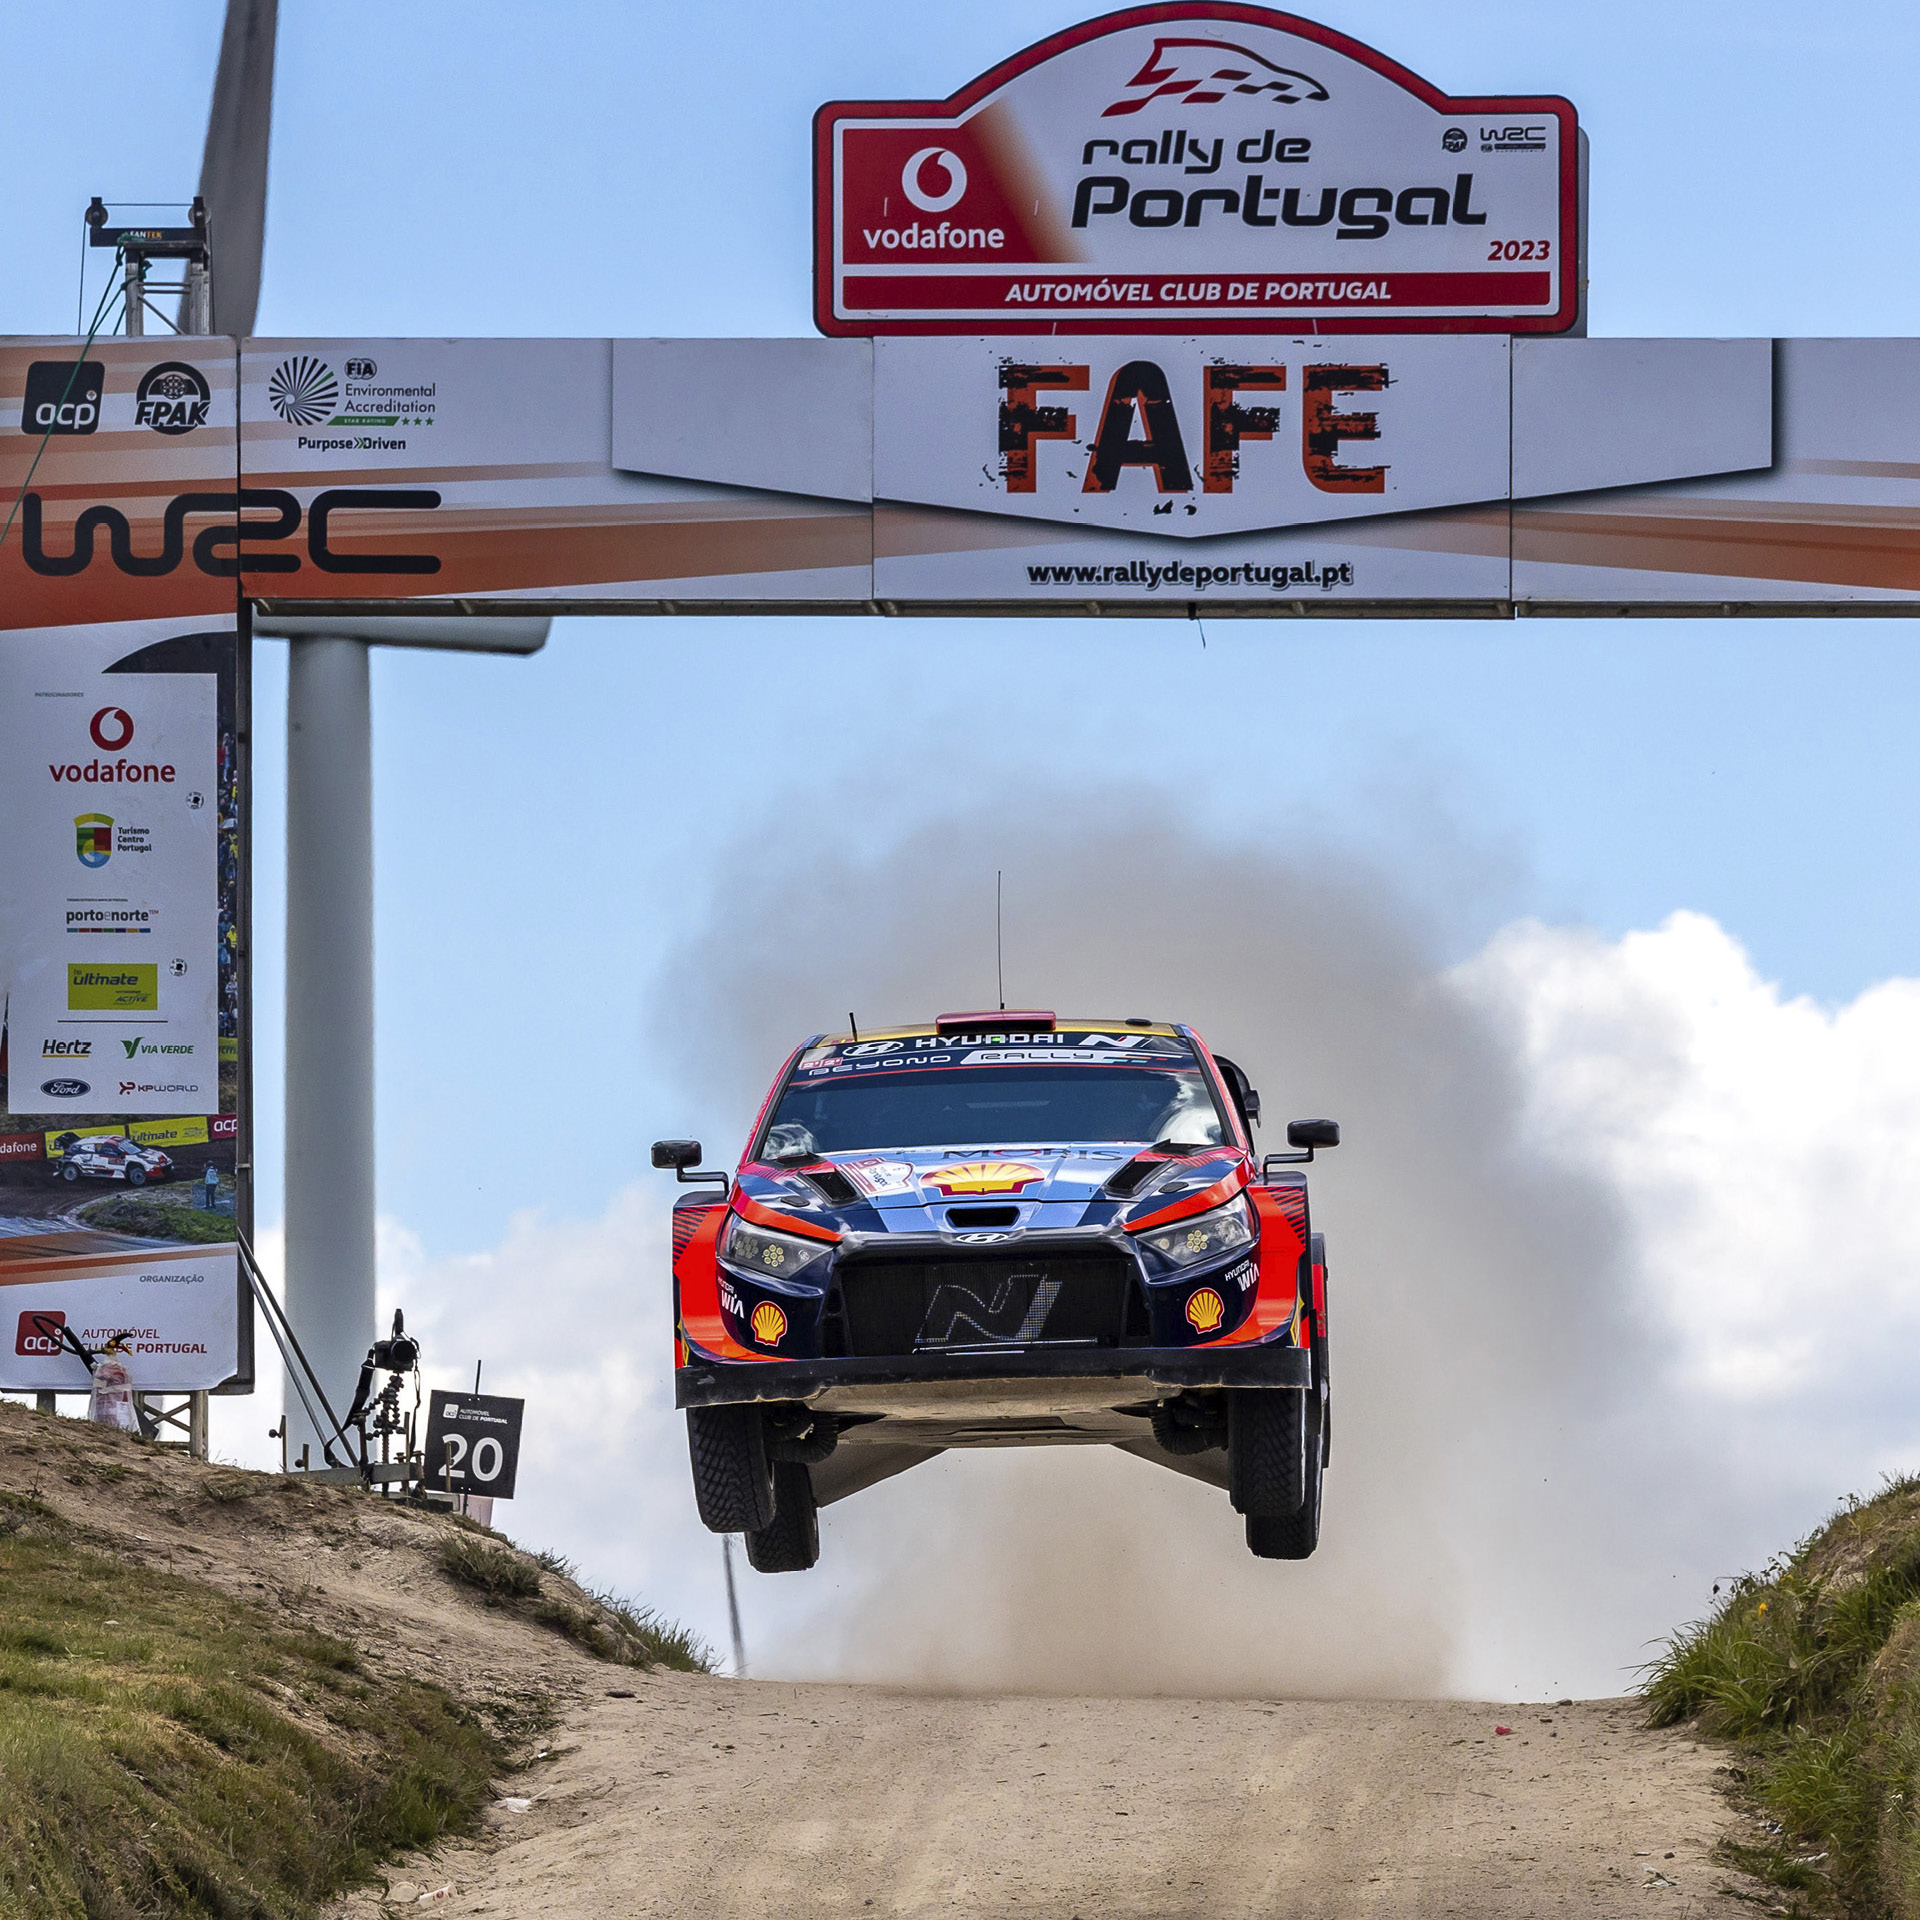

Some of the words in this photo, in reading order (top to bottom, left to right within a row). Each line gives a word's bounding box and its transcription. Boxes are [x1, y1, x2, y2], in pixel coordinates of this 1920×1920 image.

[1480, 126, 1546, 141] WRC
[1082, 130, 1224, 174] rally
[1236, 129, 1311, 164] de
[1071, 173, 1487, 240] Portugal
[863, 222, 1005, 249] vodafone
[1488, 240, 1550, 261] 2023
[1005, 278, 1154, 302] AUTOMÓVEL
[1159, 283, 1223, 301] CLUB
[1227, 283, 1261, 301] DE
[1265, 282, 1391, 301] PORTUGAL
[347, 362, 374, 376] FIA
[346, 382, 436, 397] Environmental
[344, 398, 436, 412] Accreditation
[36, 403, 95, 430] acp
[134, 400, 211, 427] FPAK
[998, 360, 1388, 493] FAFE
[22, 489, 442, 577] WRC
[1028, 561, 1352, 589] www.rallydeportugal.pt
[48, 759, 176, 782] vodafone
[117, 827, 150, 835] Turismo
[117, 835, 144, 843] Centro
[117, 844, 152, 853] Portugal
[73, 973, 138, 985] ultimate
[42, 1039, 92, 1054] Hertz
[915, 1033, 1064, 1047] HYUNDAI
[141, 1045, 158, 1053] VIA
[161, 1045, 194, 1053] VERDE
[809, 1054, 951, 1076] BEYOND
[981, 1052, 1094, 1060] RALLY
[50, 1081, 80, 1095] Ford
[138, 1084, 198, 1092] KPWORLD
[1225, 1260, 1250, 1281] HYUNDAI
[140, 1275, 204, 1284] ORGANIZAÇÃO
[136, 1343, 208, 1354] PORTUGAL
[438, 1433, 503, 1481] 20
